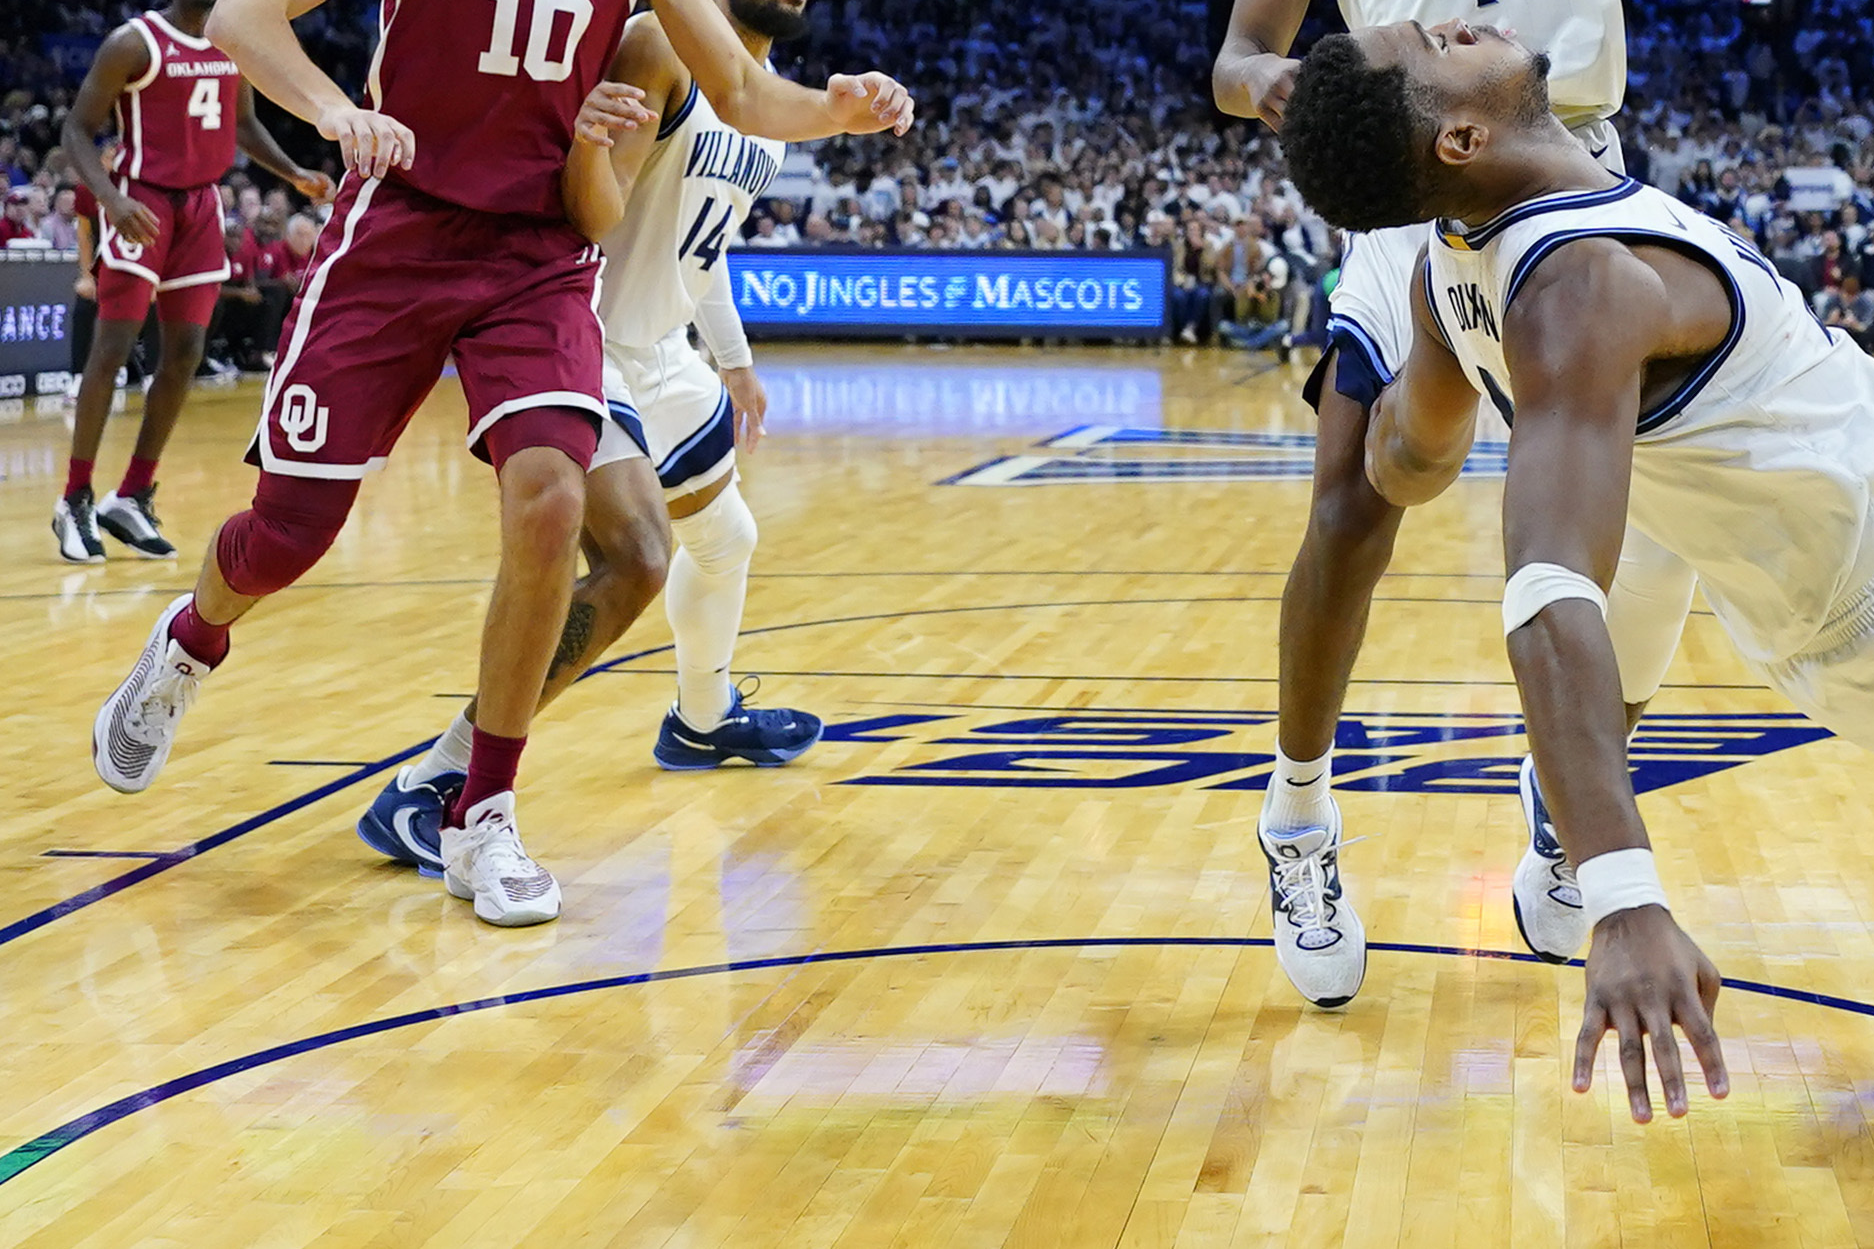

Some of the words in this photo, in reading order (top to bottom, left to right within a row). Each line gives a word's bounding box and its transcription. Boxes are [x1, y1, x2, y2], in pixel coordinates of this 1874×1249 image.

[165, 61, 239, 78] OKLAHOMA
[188, 78, 222, 130] 4
[678, 196, 734, 272] 14
[740, 270, 797, 308] NO
[796, 270, 939, 317] JINGLES
[972, 272, 1144, 311] MASCOTS
[0, 303, 67, 343] ANCE
[279, 383, 330, 453] OU
